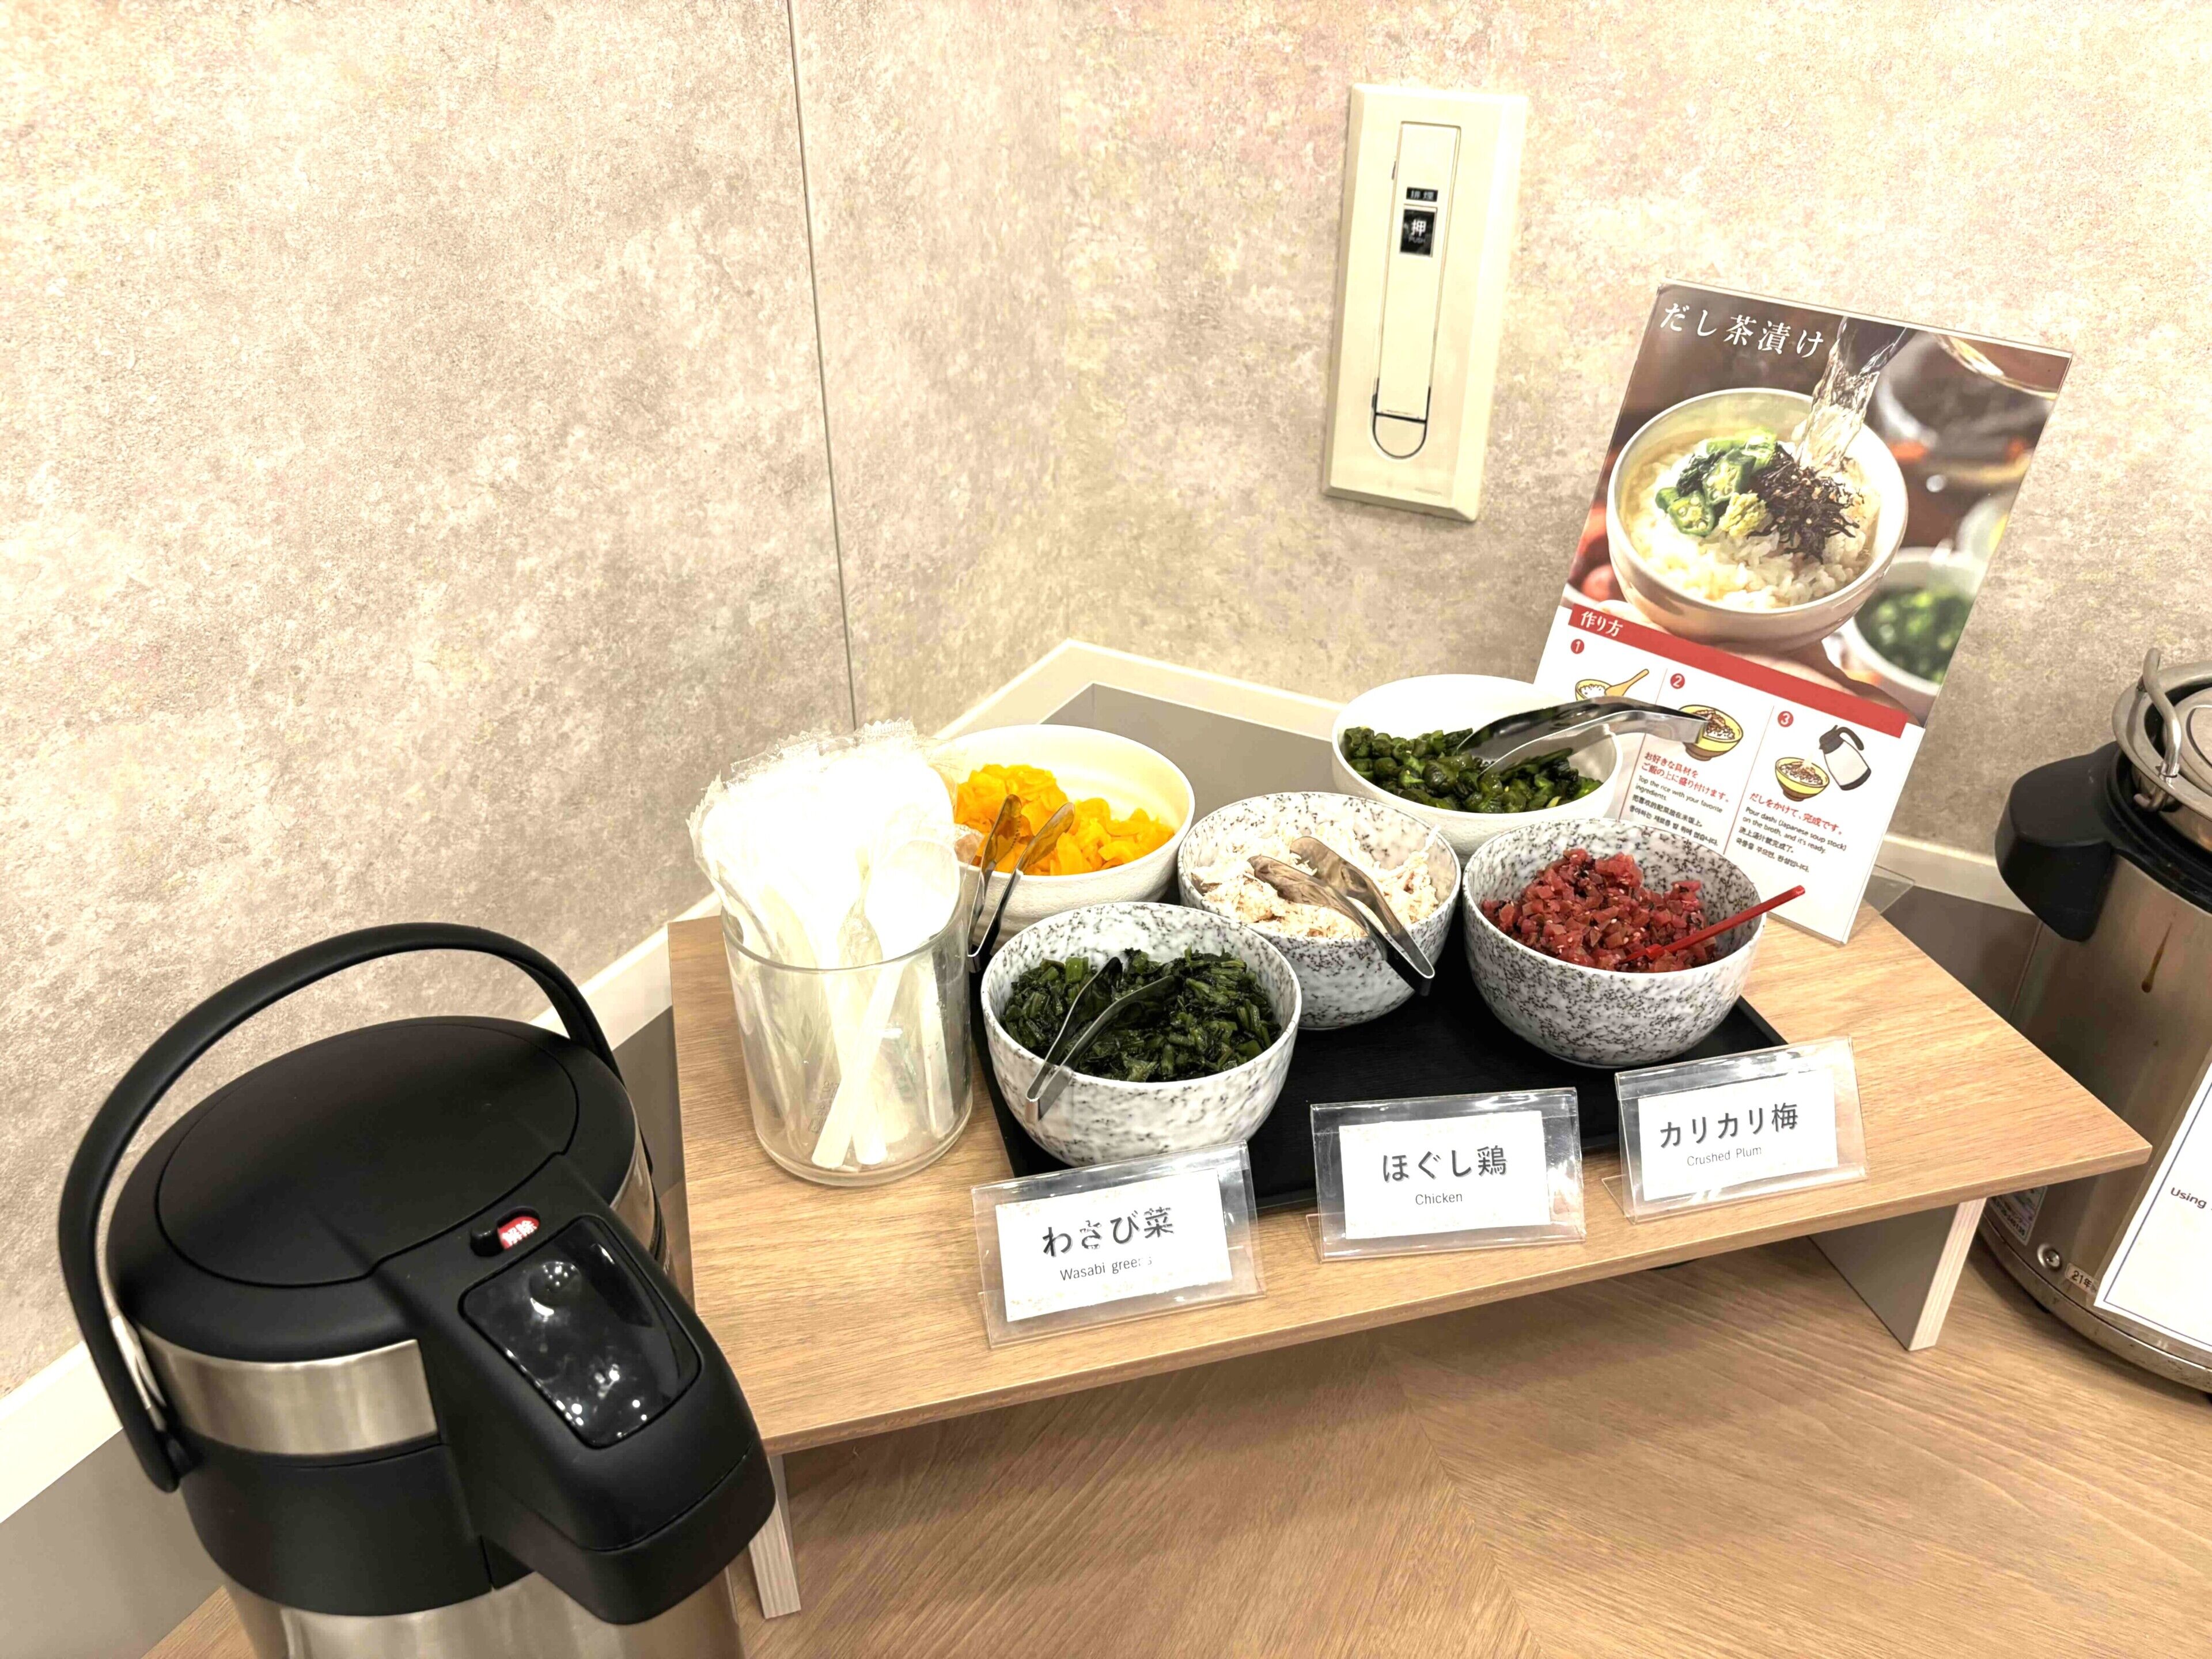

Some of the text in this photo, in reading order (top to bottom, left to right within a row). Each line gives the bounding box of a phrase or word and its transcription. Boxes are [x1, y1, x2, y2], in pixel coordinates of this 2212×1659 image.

[1411, 219, 1426, 236] 押
[1660, 303, 1824, 358] だし茶漬け
[1581, 611, 1623, 637] 作り方
[1672, 675, 1683, 688] 2
[1779, 712, 1791, 726] 3
[1645, 752, 1698, 778] お好きな具材を
[1635, 783, 1667, 801] ingredients.
[1638, 776, 1648, 784] Top
[1672, 789, 1684, 798] with
[1686, 794, 1699, 804] your
[1701, 800, 1722, 813] favorite
[1642, 763, 1729, 802] ご飯の上に盛り付けます。
[1749, 793, 1842, 835] だしをかけて、完成です。
[1746, 806, 1847, 851] Pour dashi (Japanese soup stock)
[1752, 820, 1763, 828] the
[1764, 823, 1781, 836] broth,
[1784, 834, 1796, 842] and
[1798, 837, 1806, 846] it's
[1660, 1103, 1798, 1149] カリカリ梅
[1383, 1145, 1508, 1183] ほぐし鶏
[1687, 1147, 1762, 1166] Crushed Plum
[1415, 1193, 1463, 1205] Chicken
[2171, 1187, 2207, 1209] Using
[1043, 1206, 1175, 1257] わさび菜
[1060, 1262, 1105, 1281] Wasabi
